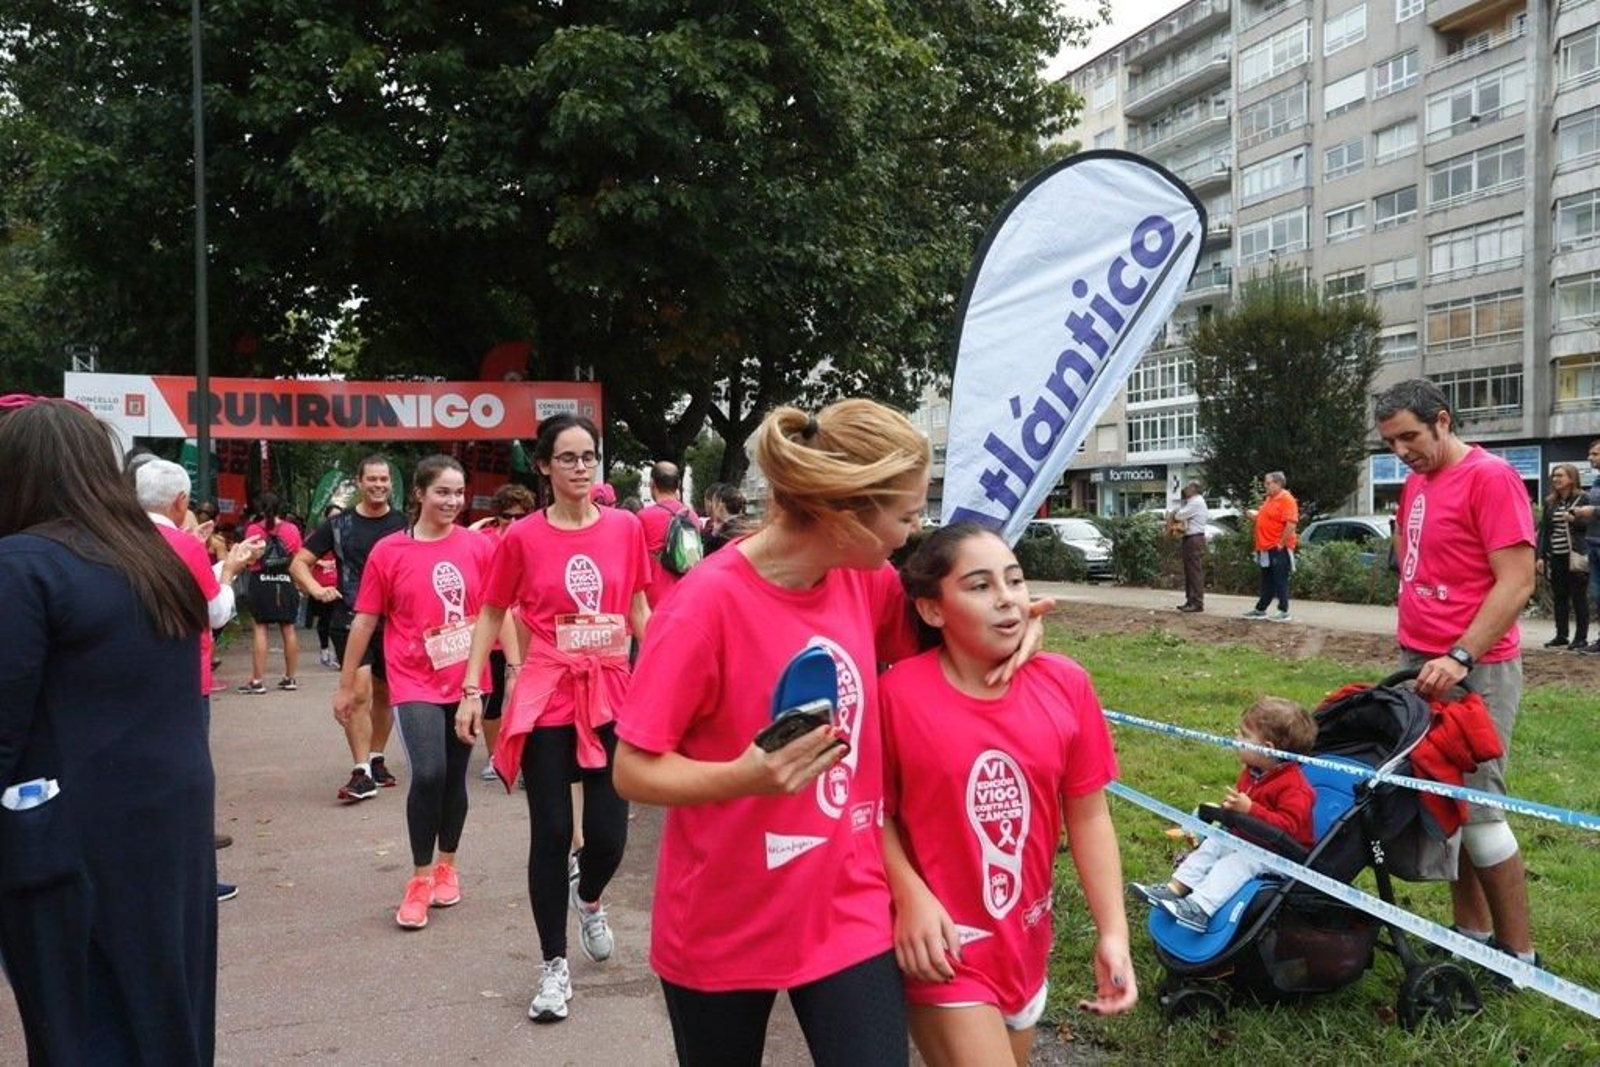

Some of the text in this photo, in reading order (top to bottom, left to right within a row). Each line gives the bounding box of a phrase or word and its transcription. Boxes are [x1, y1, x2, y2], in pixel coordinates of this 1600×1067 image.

[538, 402, 576, 410] CONCELLO
[1109, 468, 1155, 481] farmacia
[260, 573, 292, 584] GALICIA
[983, 760, 1005, 780] VI
[975, 785, 1019, 804] VIGO
